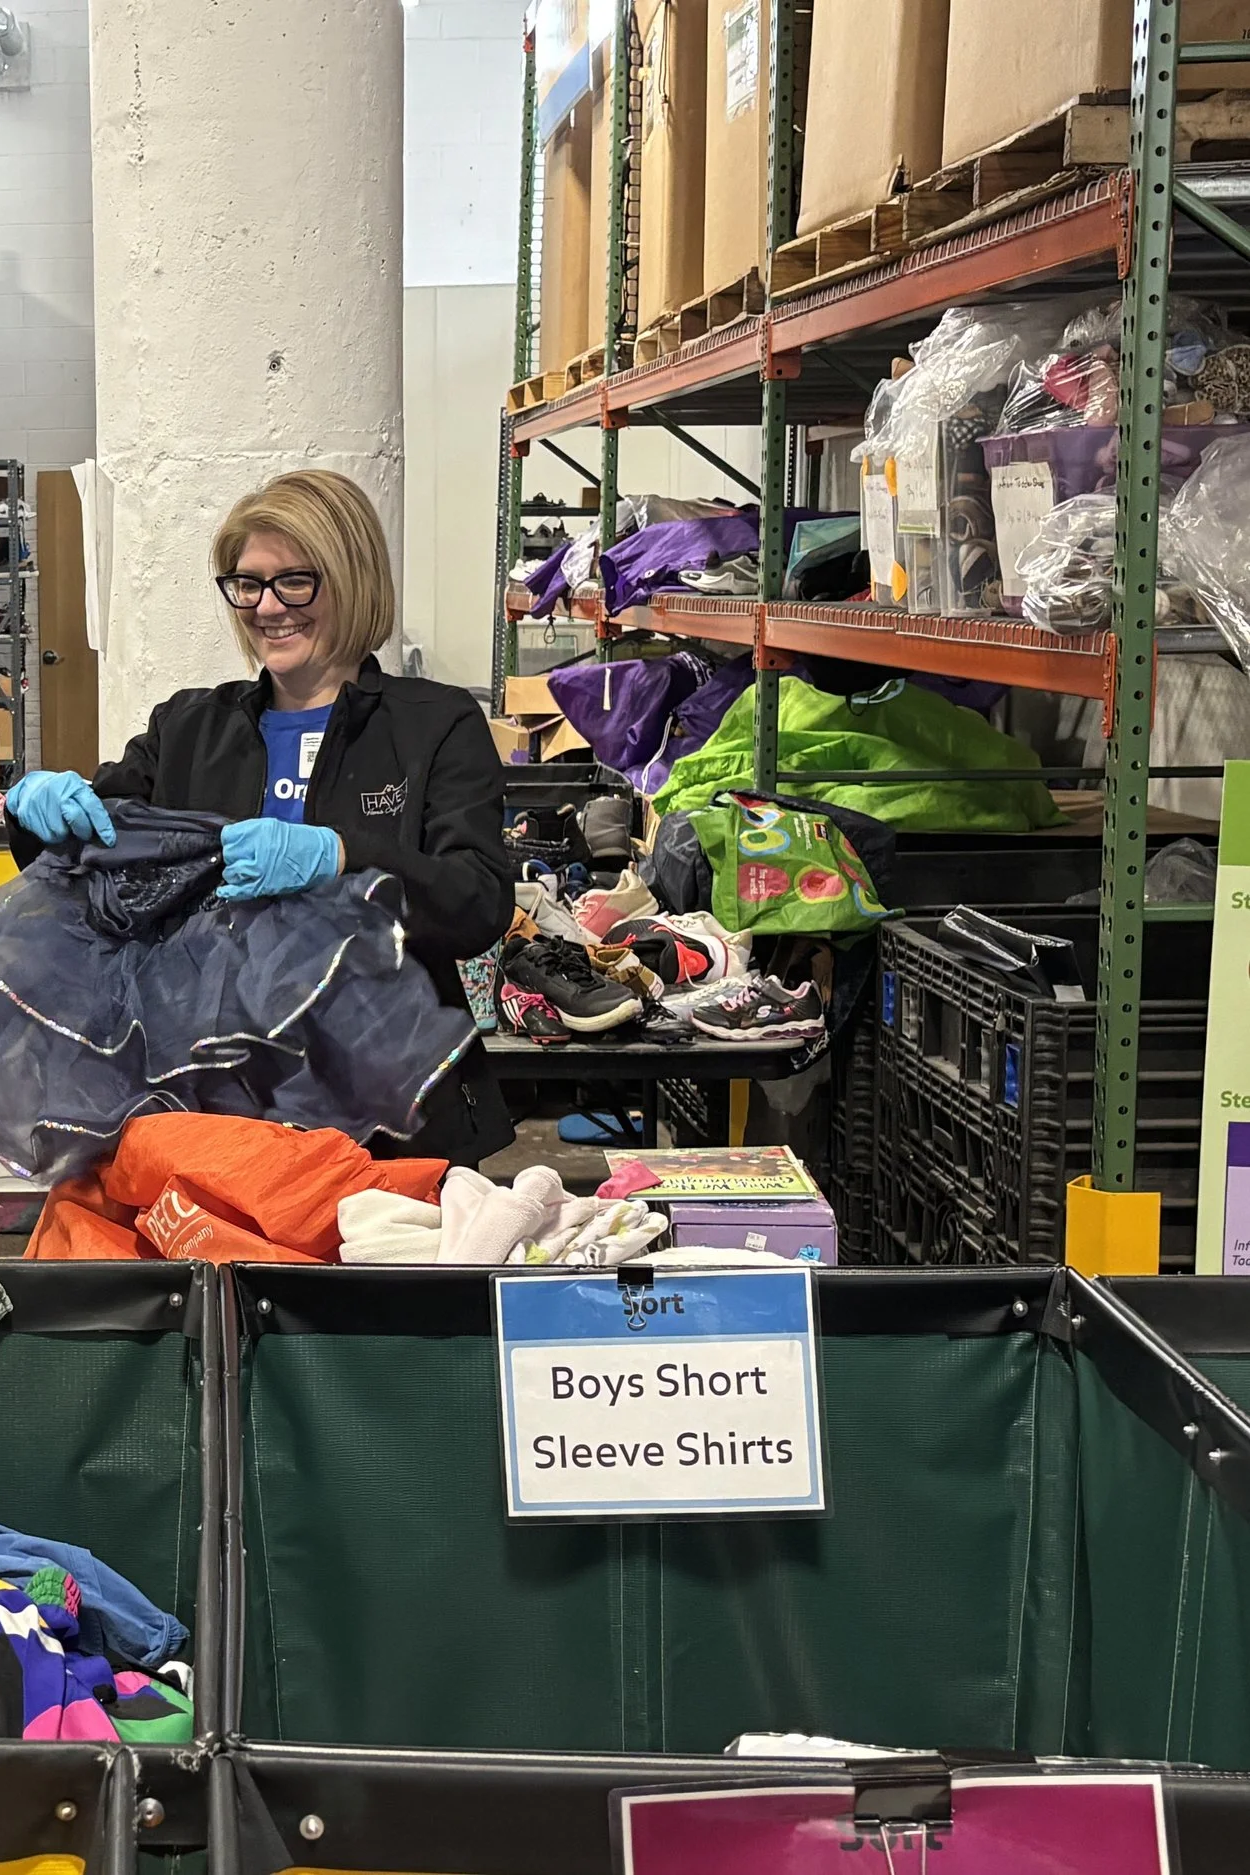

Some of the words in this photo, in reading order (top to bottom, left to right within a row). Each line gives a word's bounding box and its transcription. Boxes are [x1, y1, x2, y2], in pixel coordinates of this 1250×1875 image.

[366, 788, 406, 809] HAVE
[179, 1224, 214, 1256] Company
[622, 1290, 685, 1316] Sort
[551, 1366, 645, 1407] Boys
[656, 1363, 768, 1397] Short
[533, 1435, 665, 1469] Sleeve
[676, 1431, 793, 1467] Shirts
